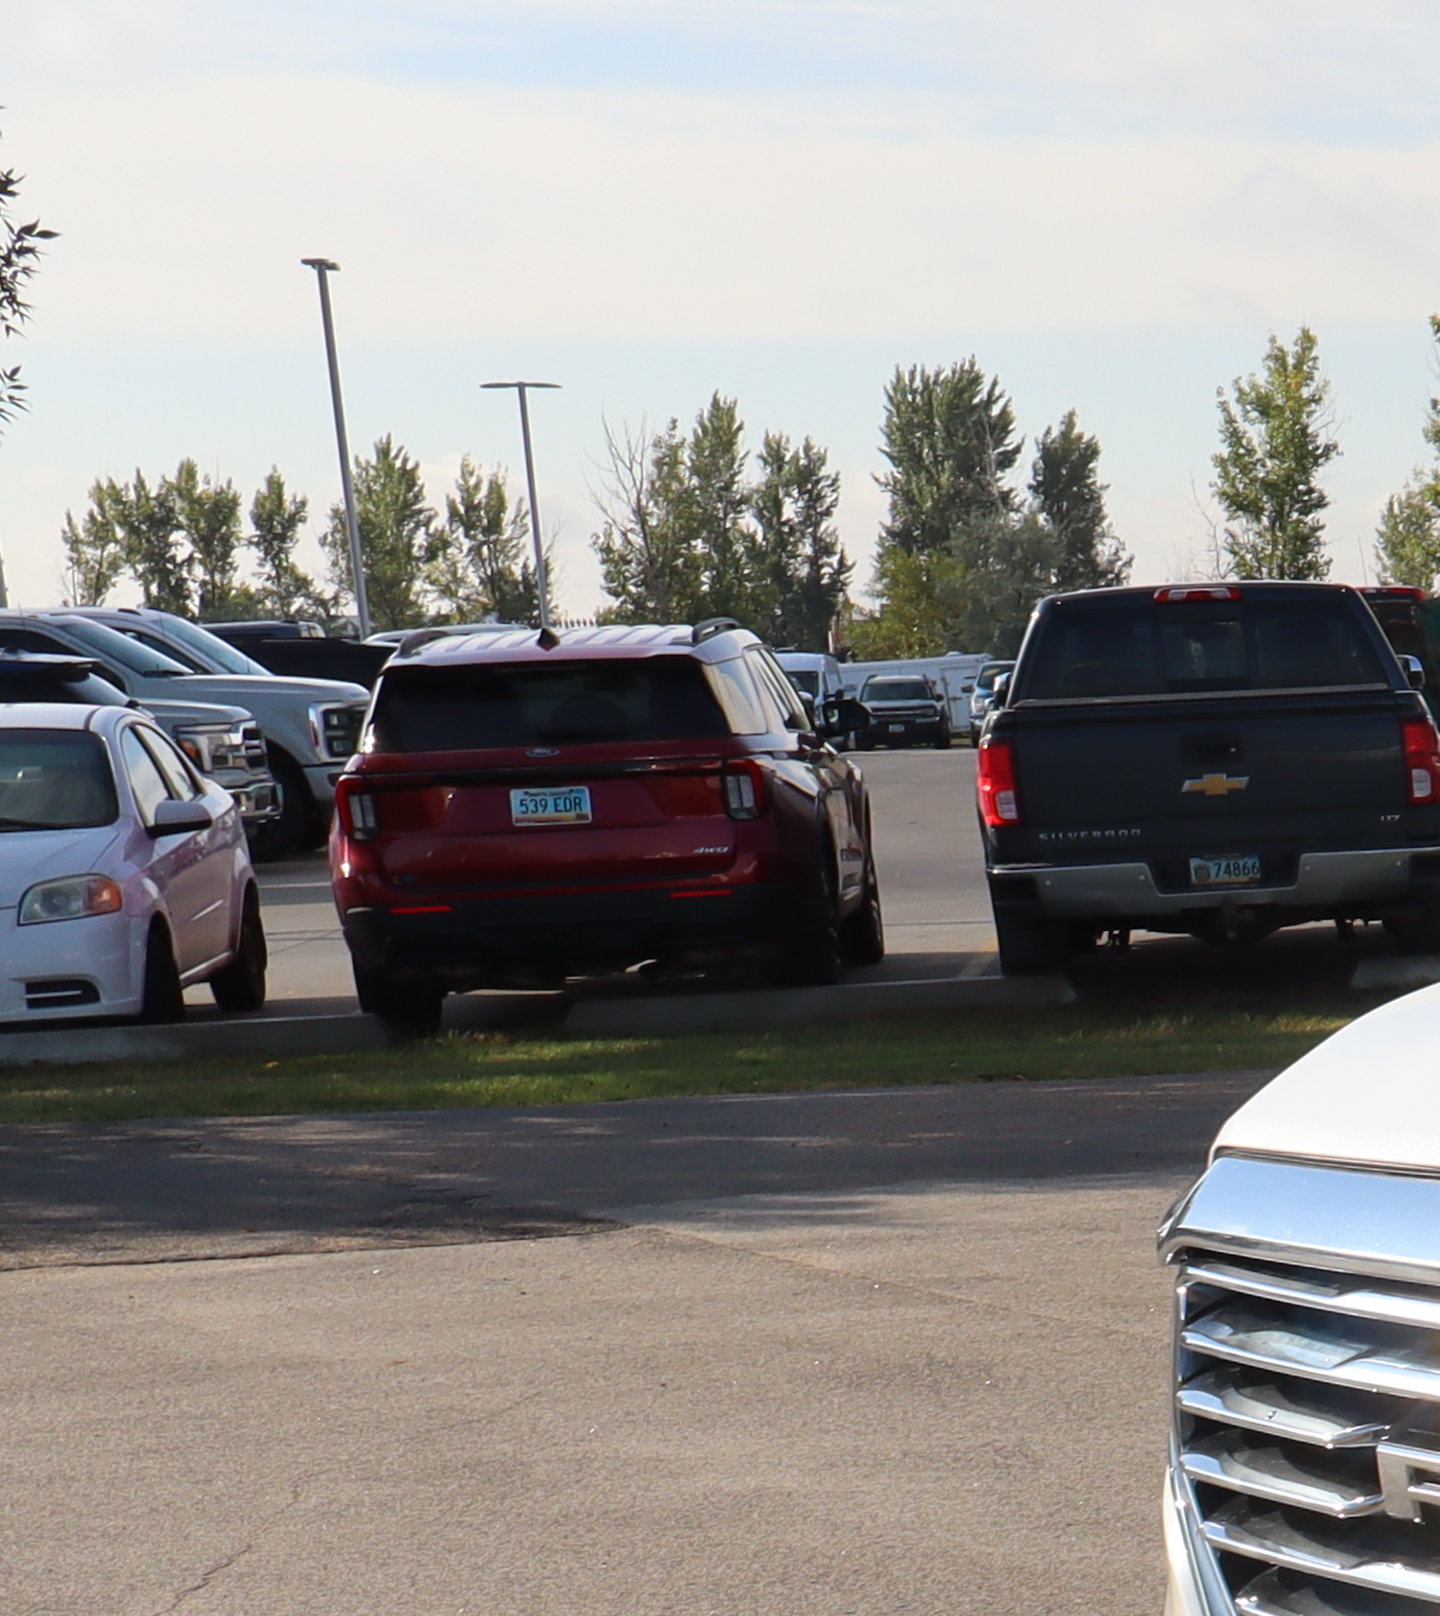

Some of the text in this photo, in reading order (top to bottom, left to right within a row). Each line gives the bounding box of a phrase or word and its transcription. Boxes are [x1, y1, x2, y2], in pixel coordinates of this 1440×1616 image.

[519, 796, 583, 814] 539 EDR
[1213, 860, 1260, 879] 74866
